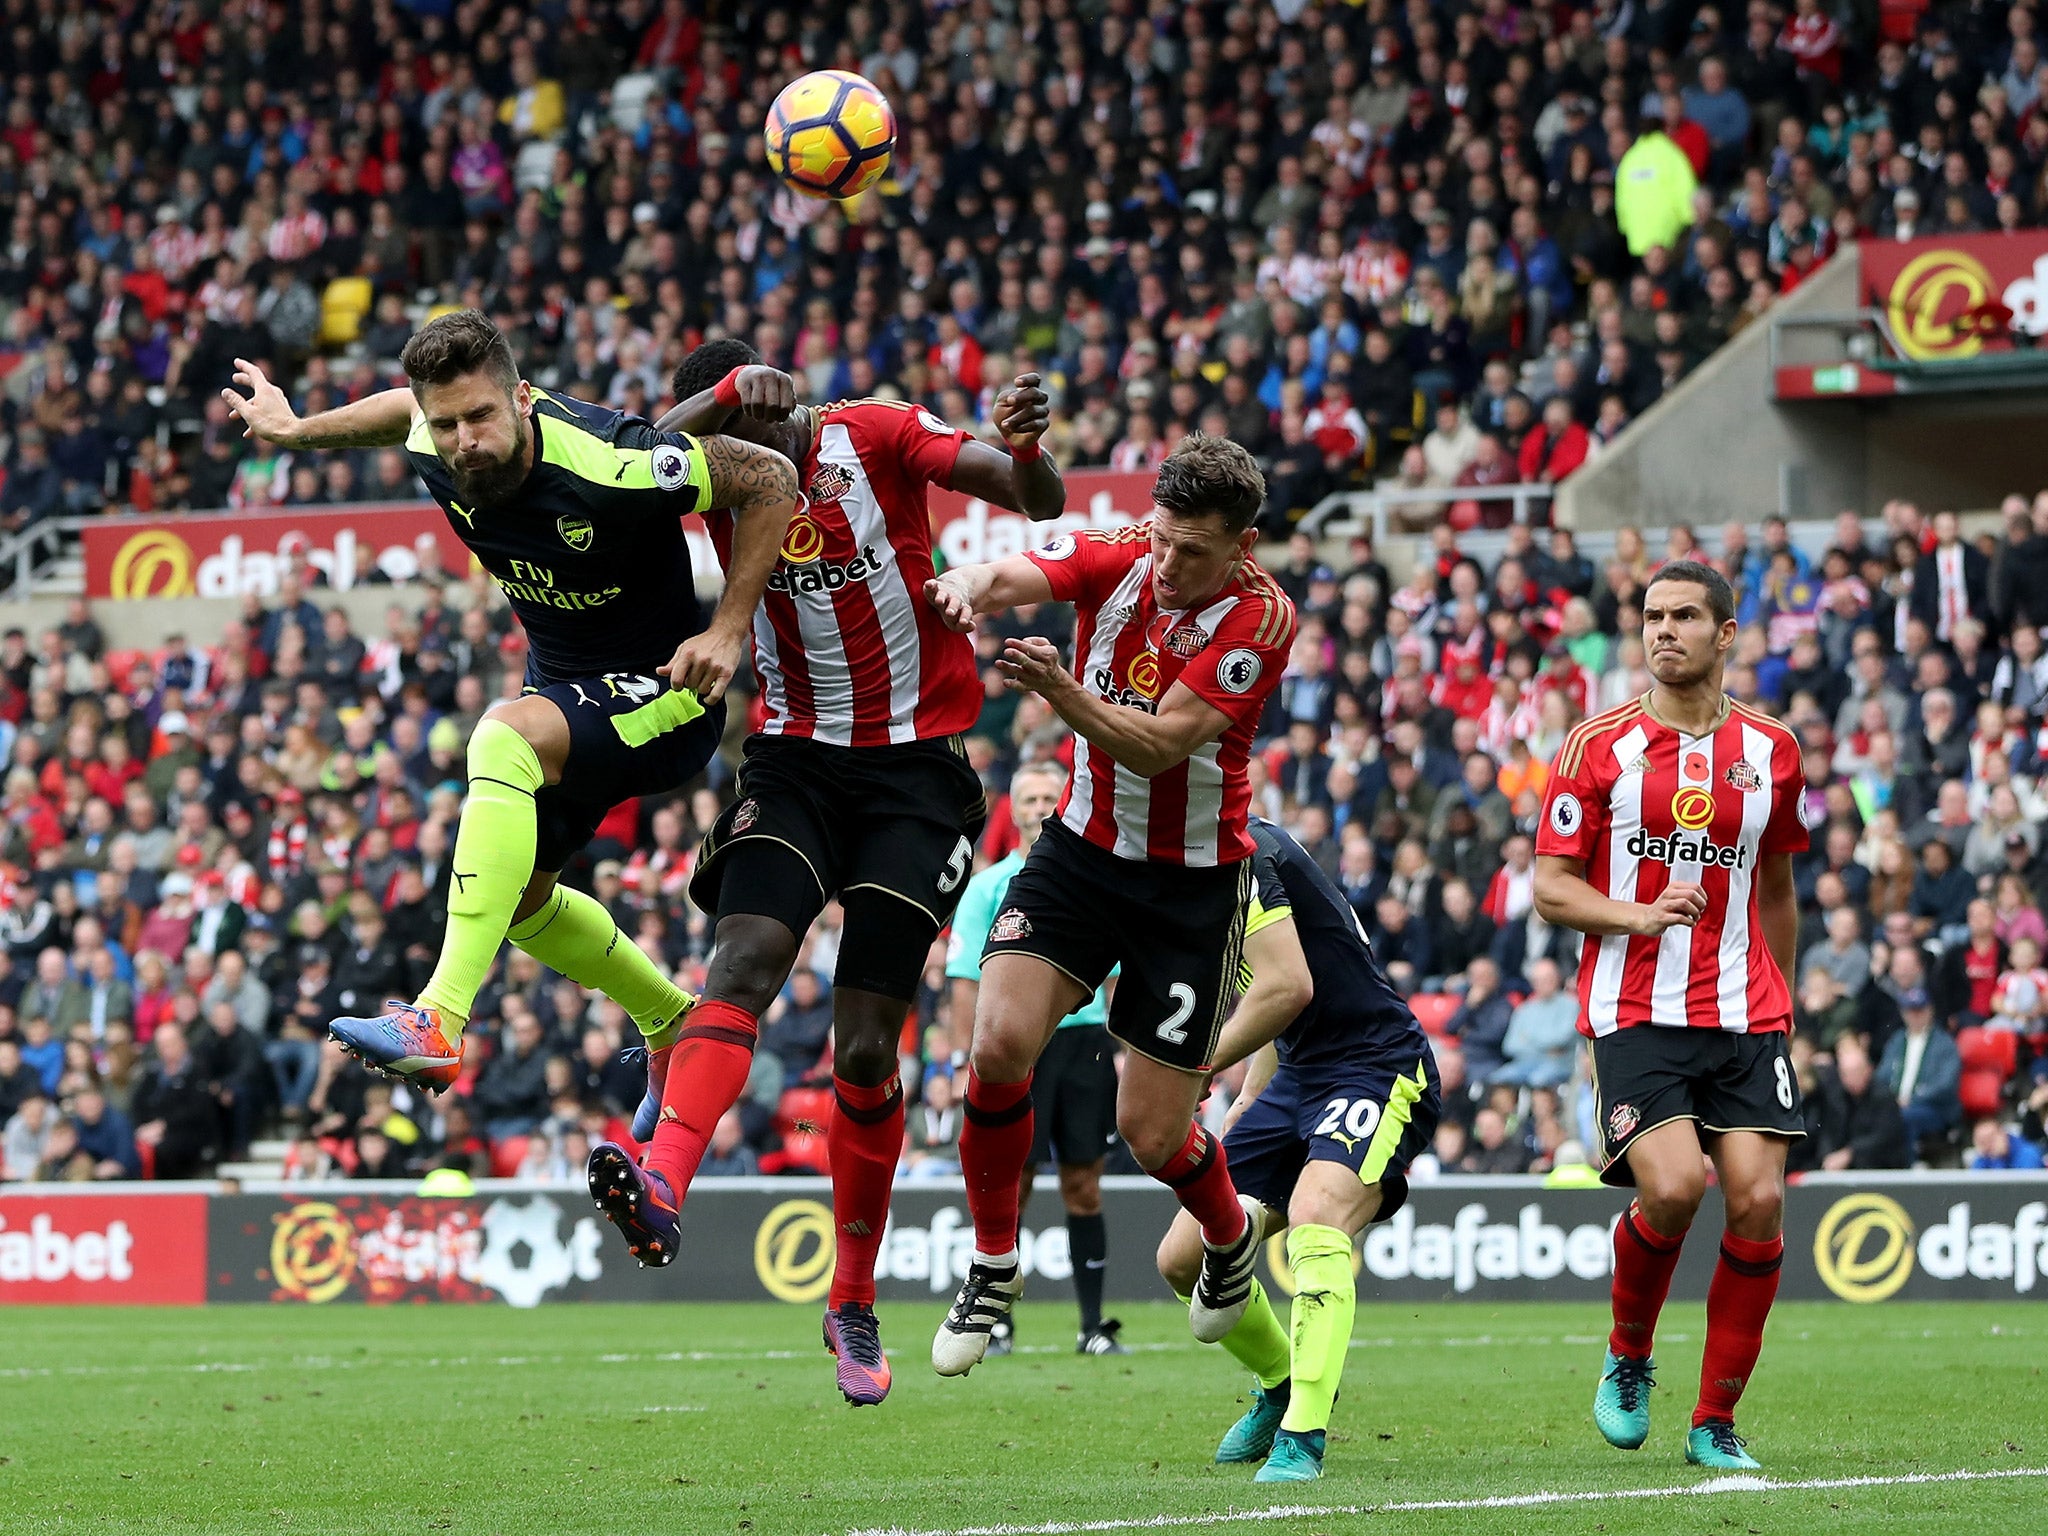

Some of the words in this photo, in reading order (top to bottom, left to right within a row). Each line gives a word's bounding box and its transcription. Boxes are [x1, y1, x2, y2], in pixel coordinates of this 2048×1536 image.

[498, 579, 622, 610] mirates
[510, 559, 553, 587] Fly
[938, 835, 973, 893] 5
[1627, 829, 1746, 869] dafabet
[1156, 982, 1196, 1044] 2
[1774, 1056, 1793, 1110] 8
[1314, 1097, 1381, 1139] 20
[0, 1212, 134, 1282] abet
[1363, 1203, 1621, 1293] dafabe
[1917, 1201, 2048, 1293] daf
